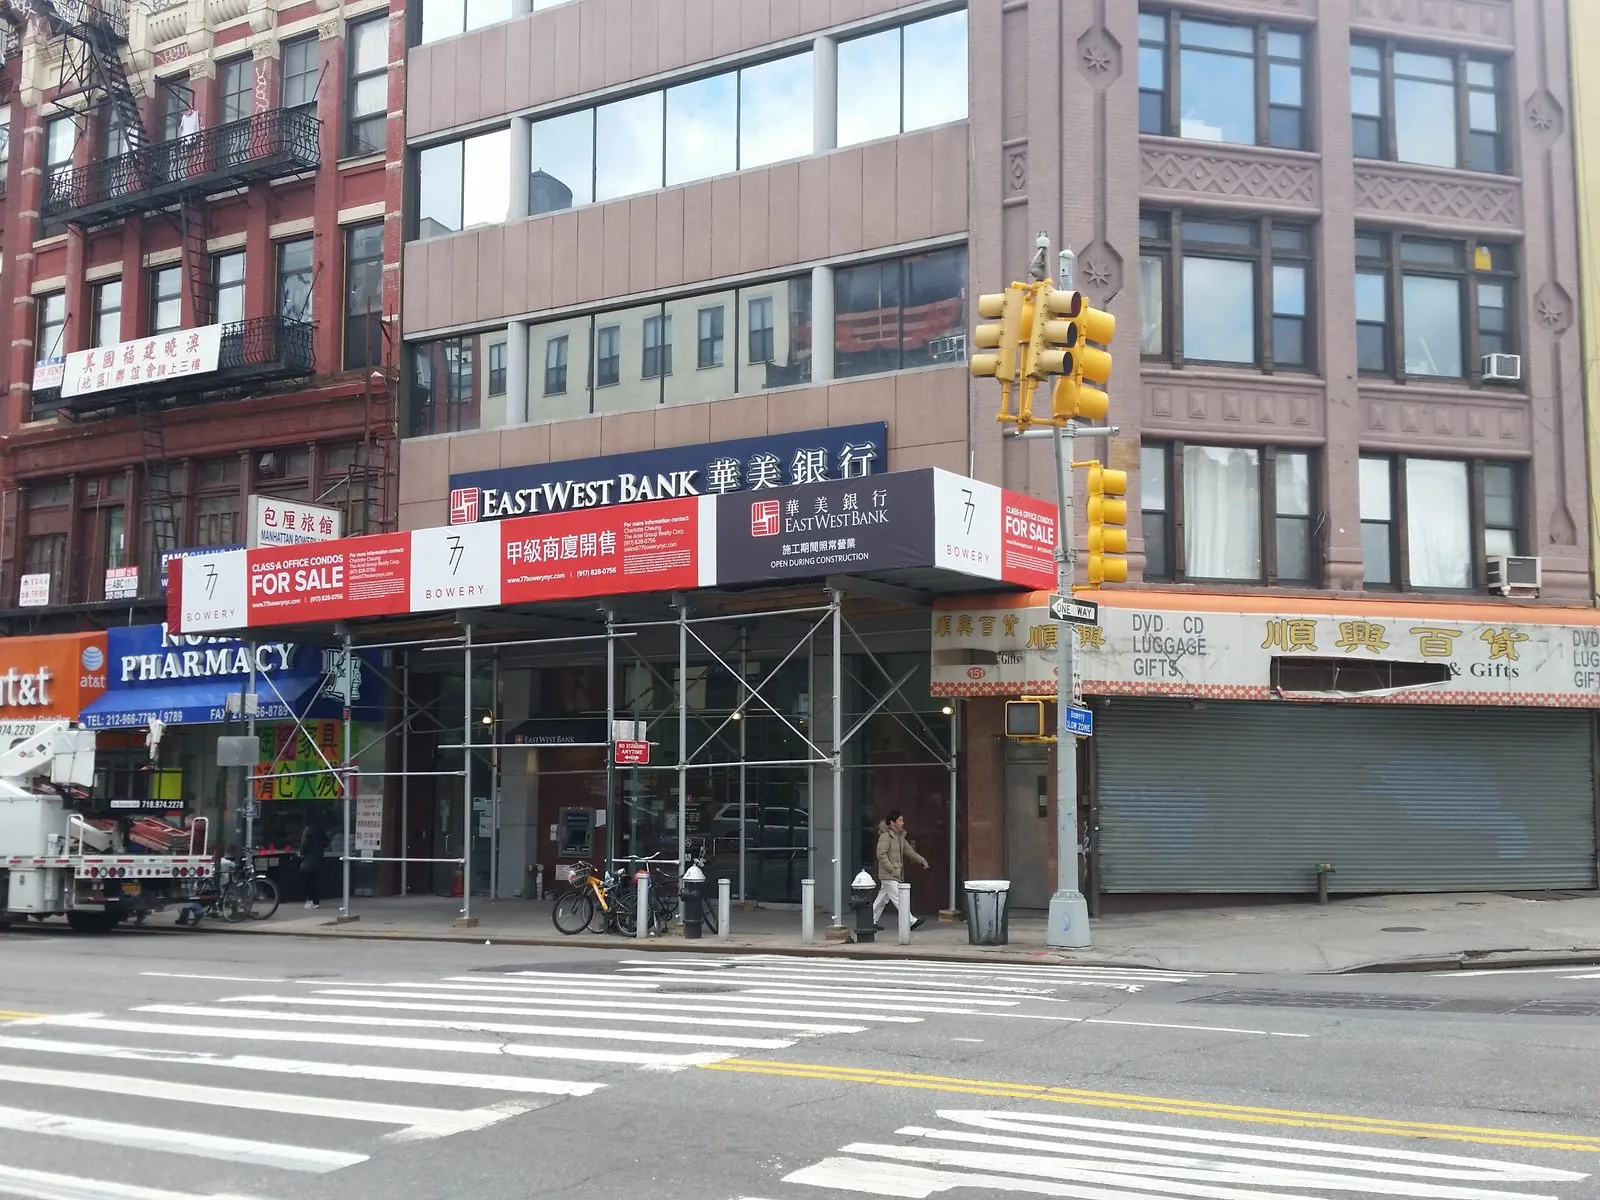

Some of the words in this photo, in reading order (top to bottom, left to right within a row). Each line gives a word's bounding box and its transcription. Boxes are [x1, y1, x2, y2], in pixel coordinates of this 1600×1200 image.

[707, 441, 875, 494] 華美銀行
[618, 470, 700, 503] BANK
[784, 489, 888, 517] 華美銀行
[264, 506, 334, 536] 包厘旅館
[852, 509, 889, 526] BANK
[261, 530, 293, 544] MANHATTAN
[1005, 515, 1028, 538] FOR
[1029, 522, 1054, 545] SALE
[506, 530, 617, 566] 甲級商廈開售
[782, 537, 856, 556] 施工期間照常營業
[946, 544, 990, 564] BOWERY
[283, 558, 310, 568] OFFICE
[310, 554, 344, 566] CONDOS
[770, 560, 788, 569] OPEN
[789, 557, 815, 567] DURING
[816, 552, 869, 565] CONSTRUCTION
[252, 571, 291, 596] FOR
[294, 566, 344, 592] SALE
[425, 585, 484, 599] BOWERY
[186, 609, 236, 622] BOWERY
[1056, 602, 1071, 615] ONE
[1076, 606, 1093, 618] WAY
[1132, 613, 1163, 632] DVD
[1183, 616, 1204, 634] CD
[1133, 635, 1207, 656] LUGGAGE
[1260, 618, 1529, 661] 順興百貨
[1572, 630, 1600, 647] DVD
[120, 643, 294, 682] PHARMACY
[1133, 658, 1178, 677] GIFTS
[1470, 662, 1520, 678] Gifts
[80, 674, 105, 689] at&t
[968, 668, 984, 679] 151
[86, 714, 104, 728] TEL:
[163, 710, 183, 723] 9789
[1066, 719, 1077, 729] SLOW
[1078, 723, 1091, 733] ZONE
